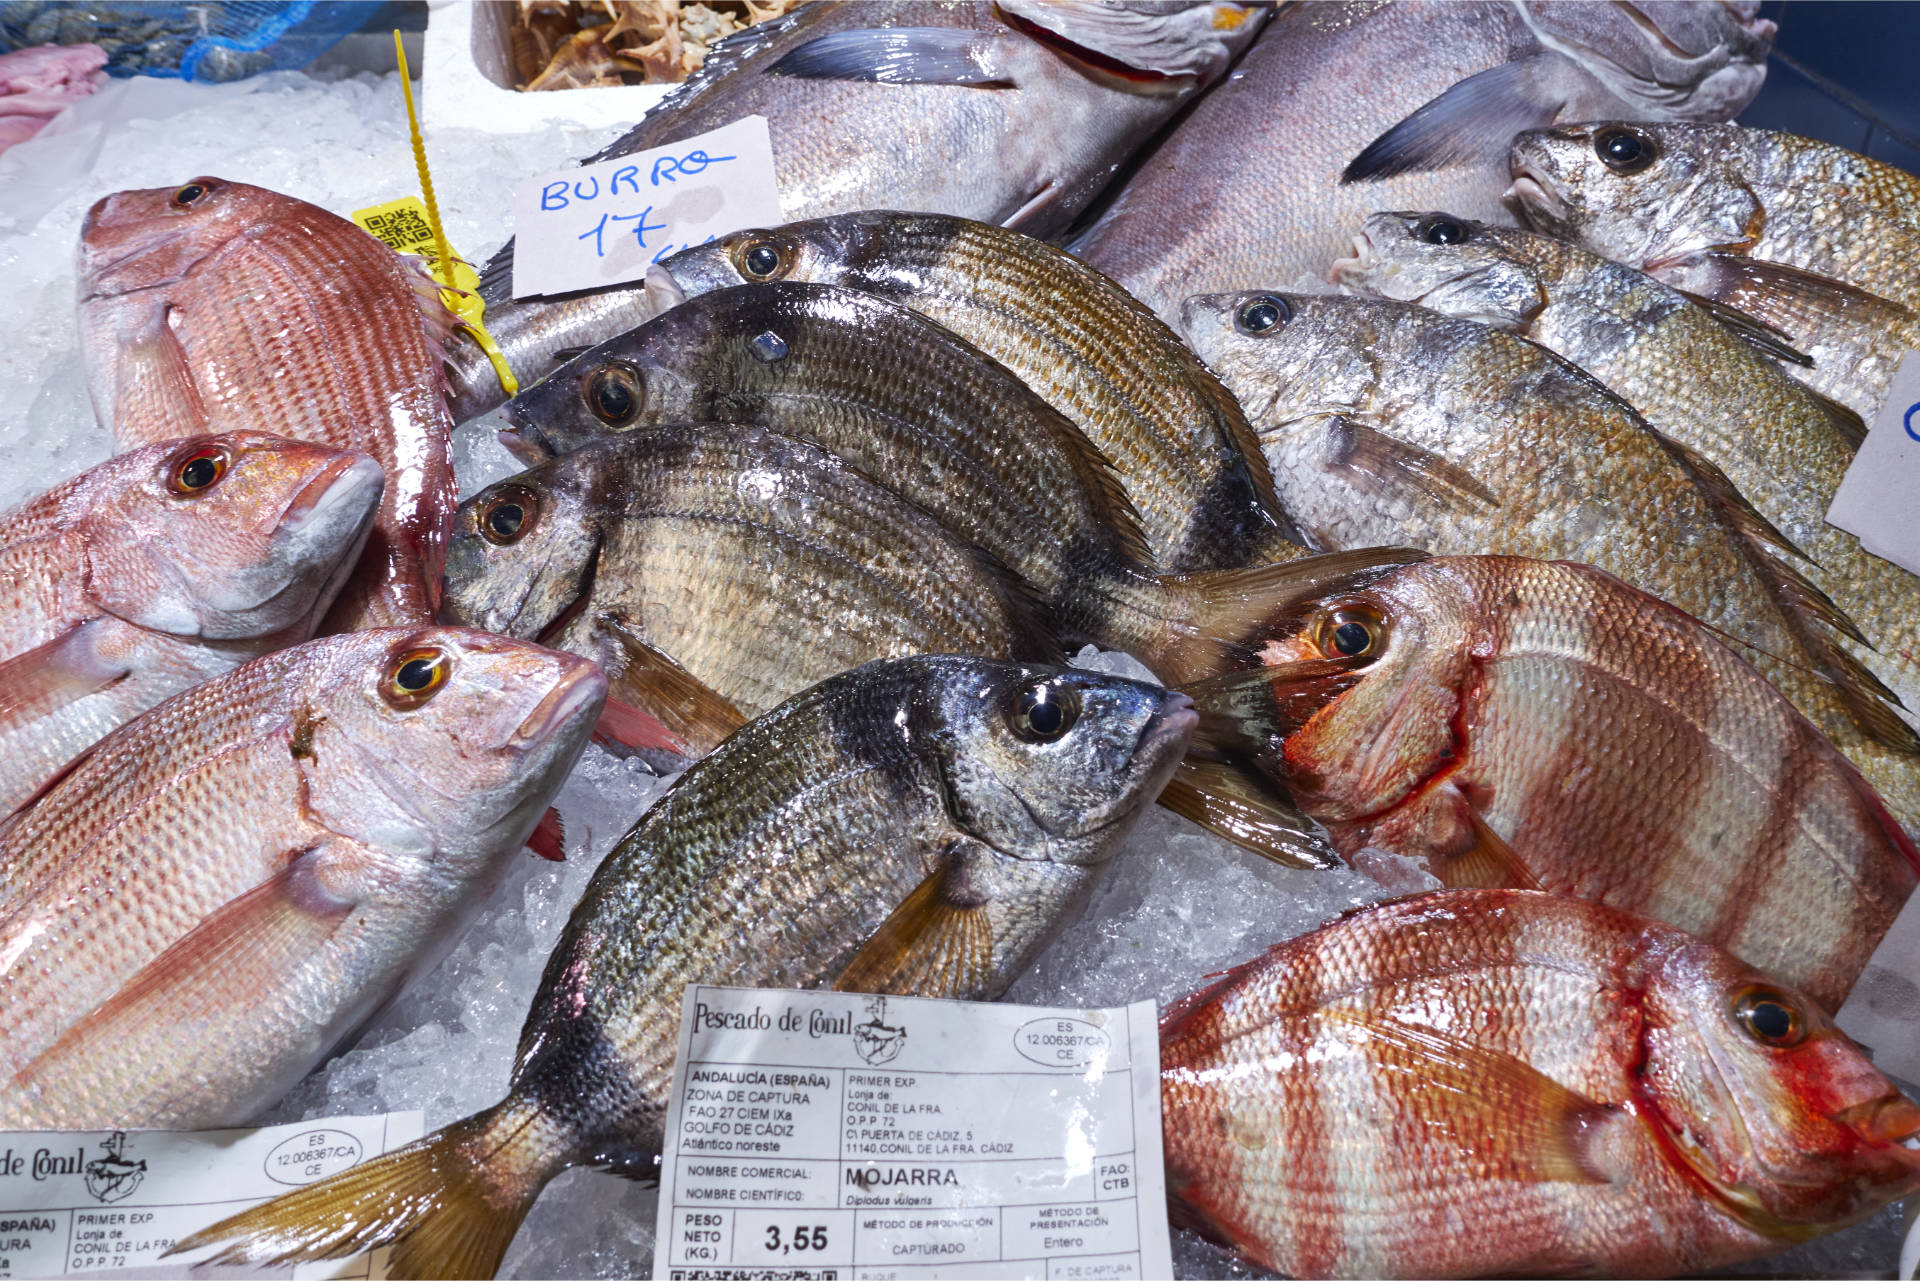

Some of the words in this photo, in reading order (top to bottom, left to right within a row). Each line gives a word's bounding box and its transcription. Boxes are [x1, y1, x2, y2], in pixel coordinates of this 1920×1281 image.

[541, 150, 737, 211] BURRO
[578, 206, 667, 257] 17
[693, 1003, 771, 1034] Pescado
[778, 1007, 802, 1032] de
[809, 1008, 852, 1039] Conil
[1057, 1022, 1074, 1032] ES
[1057, 1049, 1074, 1060] CE
[692, 1071, 767, 1084] ANDALUCÍA
[770, 1074, 831, 1089] (ESPAÑA)
[850, 1075, 891, 1087] PRIMER
[687, 1089, 723, 1101] ZONA
[727, 1091, 745, 1103] DE
[749, 1092, 810, 1105] CAPTURA
[849, 1090, 874, 1101] Lonja
[689, 1106, 716, 1118] FAO
[720, 1107, 734, 1119] 27
[737, 1108, 769, 1120] CIEM
[774, 1110, 792, 1121] IXa
[848, 1102, 880, 1113] CONIL
[884, 1104, 899, 1113] DE
[903, 1104, 916, 1113] LA
[883, 1117, 895, 1127] 72
[684, 1122, 731, 1134] GOLFO
[734, 1124, 752, 1135] DE
[755, 1122, 794, 1137] CÁDIZ
[309, 1135, 325, 1146] ES
[861, 1131, 904, 1140] PUERTA
[909, 1131, 923, 1141] DE
[967, 1132, 973, 1141] 5
[683, 1138, 733, 1150] Atlántico
[735, 1141, 781, 1152] noreste
[917, 1144, 932, 1154] DE
[936, 1144, 949, 1154] LA
[0, 1150, 24, 1176] de
[32, 1147, 84, 1181] Conil
[305, 1164, 322, 1176] CE
[688, 1166, 738, 1177] NOMBRE
[846, 1168, 959, 1186] MOJARRA
[1103, 1178, 1129, 1190] CTB
[686, 1189, 736, 1200] NOMBRE
[846, 1195, 890, 1206] Diplodus
[1039, 1207, 1082, 1217] MÉTODO
[1086, 1207, 1099, 1216] DE
[0, 1217, 56, 1233] SPAÑA)
[78, 1215, 126, 1226] PRIMER
[685, 1214, 722, 1226] PESO
[863, 1219, 906, 1229] MÉTODO
[909, 1220, 922, 1228] DE
[1030, 1216, 1109, 1229] PRESENTACIÓN
[77, 1230, 105, 1241] Lonja
[684, 1231, 721, 1242] NETO
[764, 1225, 828, 1255] 3,55
[74, 1242, 111, 1254] CONIL
[115, 1240, 132, 1249] DE
[136, 1240, 150, 1250] LA
[892, 1243, 966, 1255] CAPTURADO
[1044, 1237, 1084, 1249] Entero
[684, 1247, 718, 1261] (KG.)
[112, 1256, 125, 1266] 72
[1067, 1268, 1082, 1277] DE
[1084, 1264, 1133, 1276] CAPTURA
